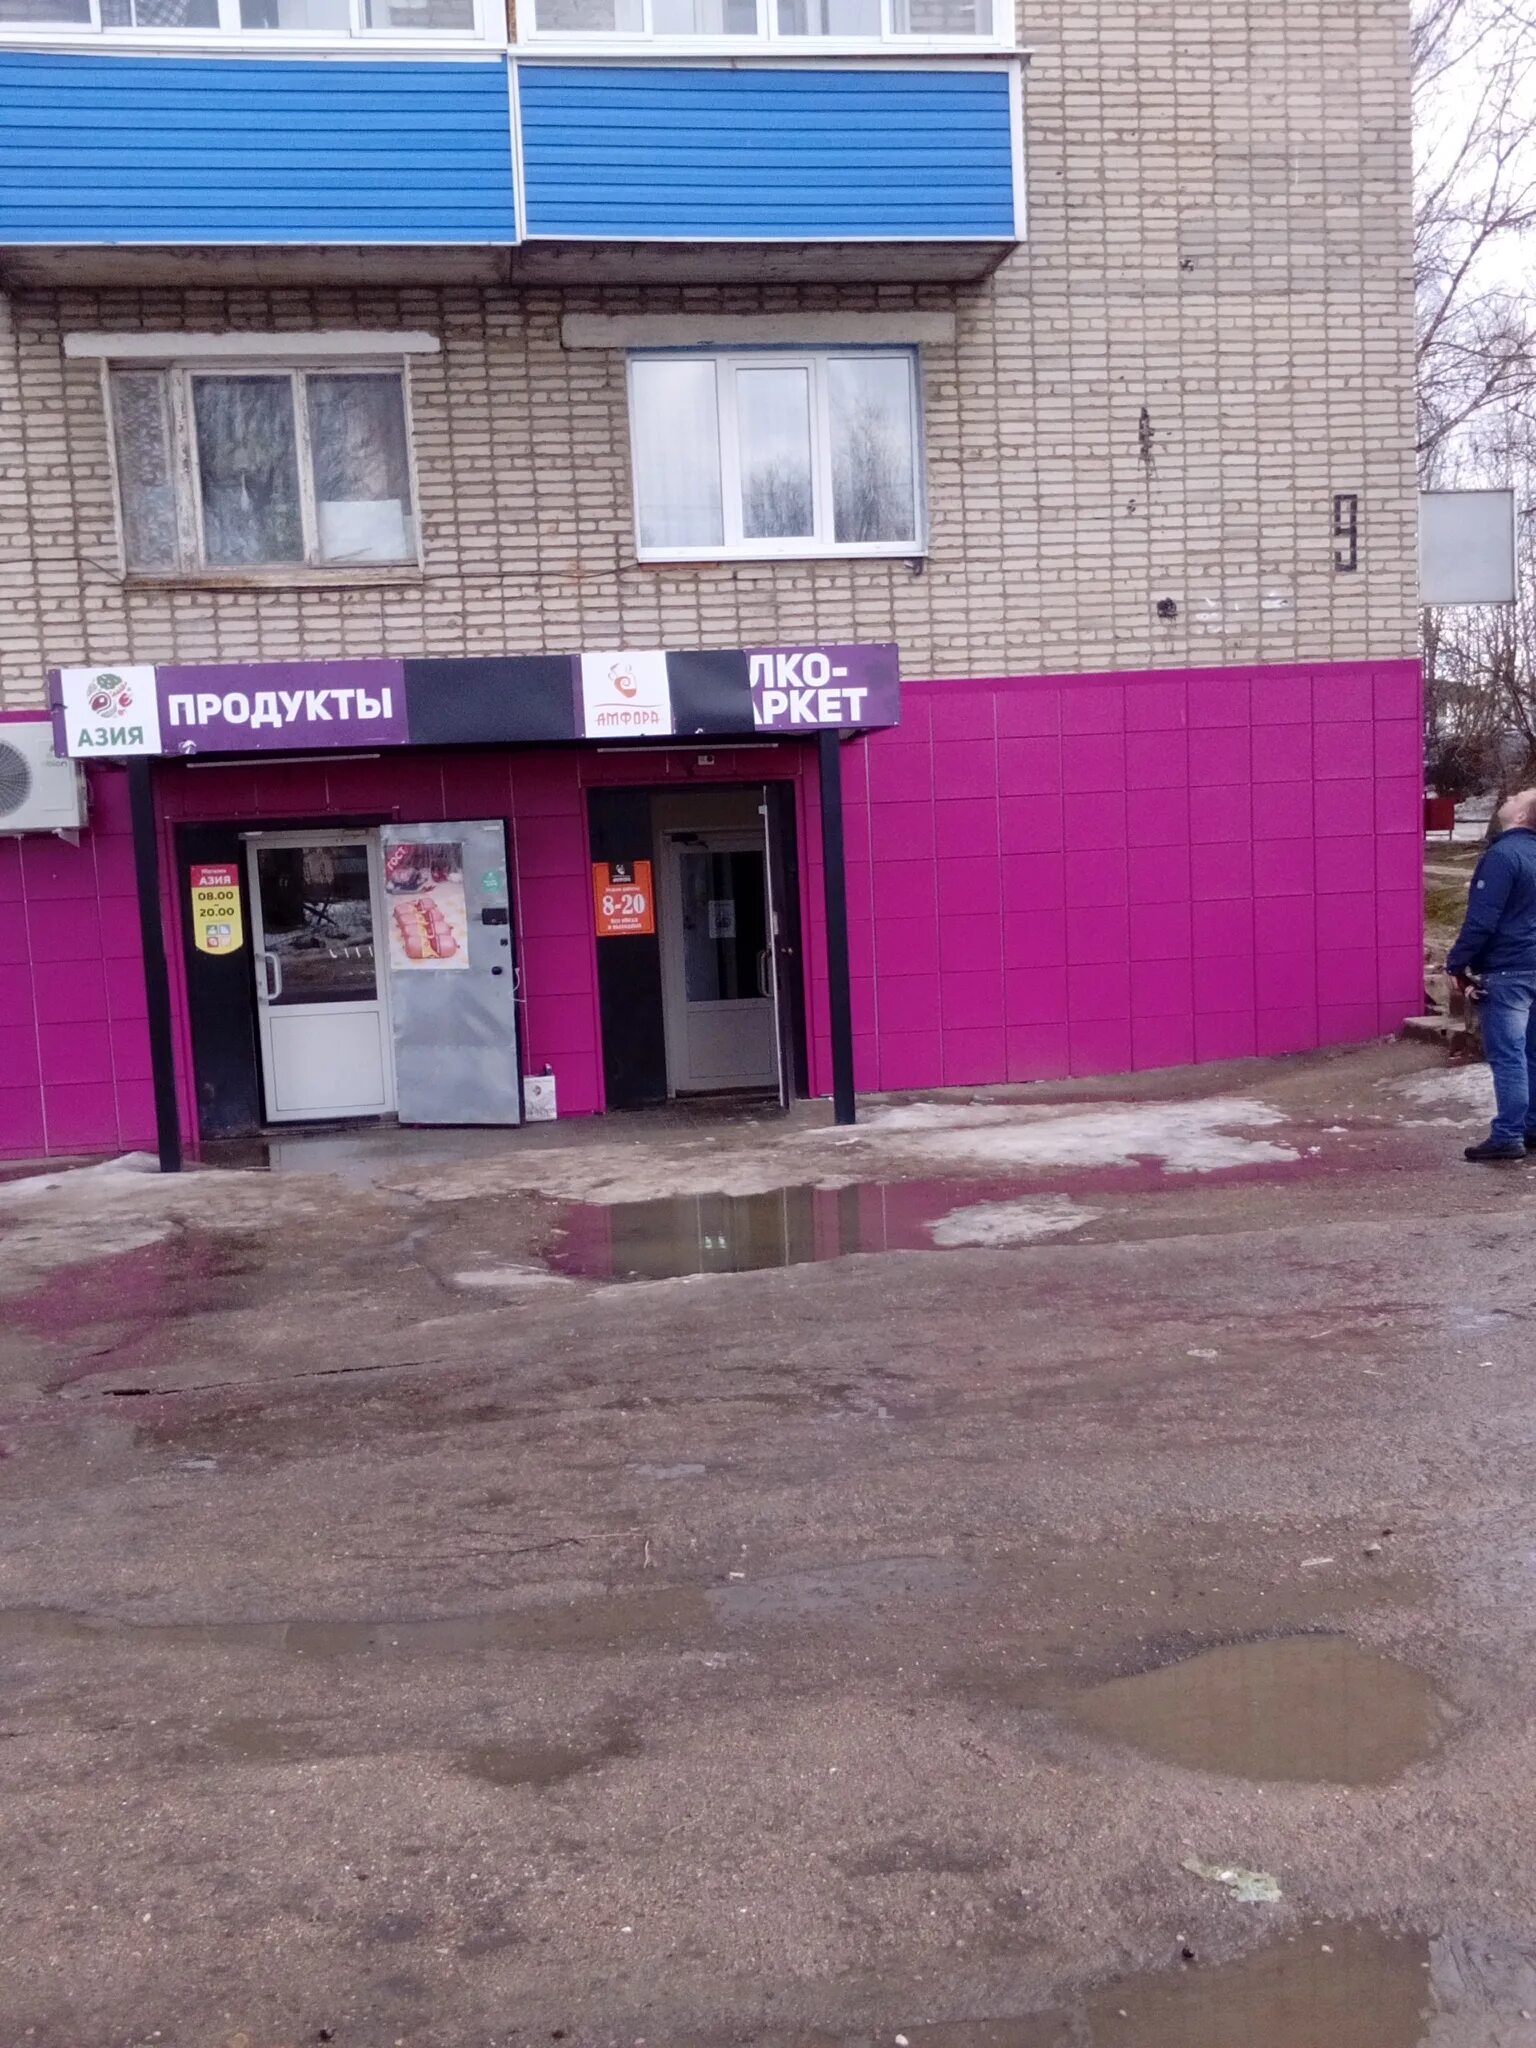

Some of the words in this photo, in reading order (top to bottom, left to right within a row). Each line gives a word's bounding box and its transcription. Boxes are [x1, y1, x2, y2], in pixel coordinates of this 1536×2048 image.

[1333, 493, 1358, 572] 9
[168, 687, 394, 729] ПРОДУКТЫ
[595, 709, 660, 726] АМФОРА
[77, 725, 145, 748] АЗИЯ
[387, 845, 407, 871] ГОСТ
[199, 875, 232, 886] АЗИЯ
[197, 891, 234, 901] 08.00
[602, 893, 646, 916] 8-20
[199, 907, 235, 918] 20.00
